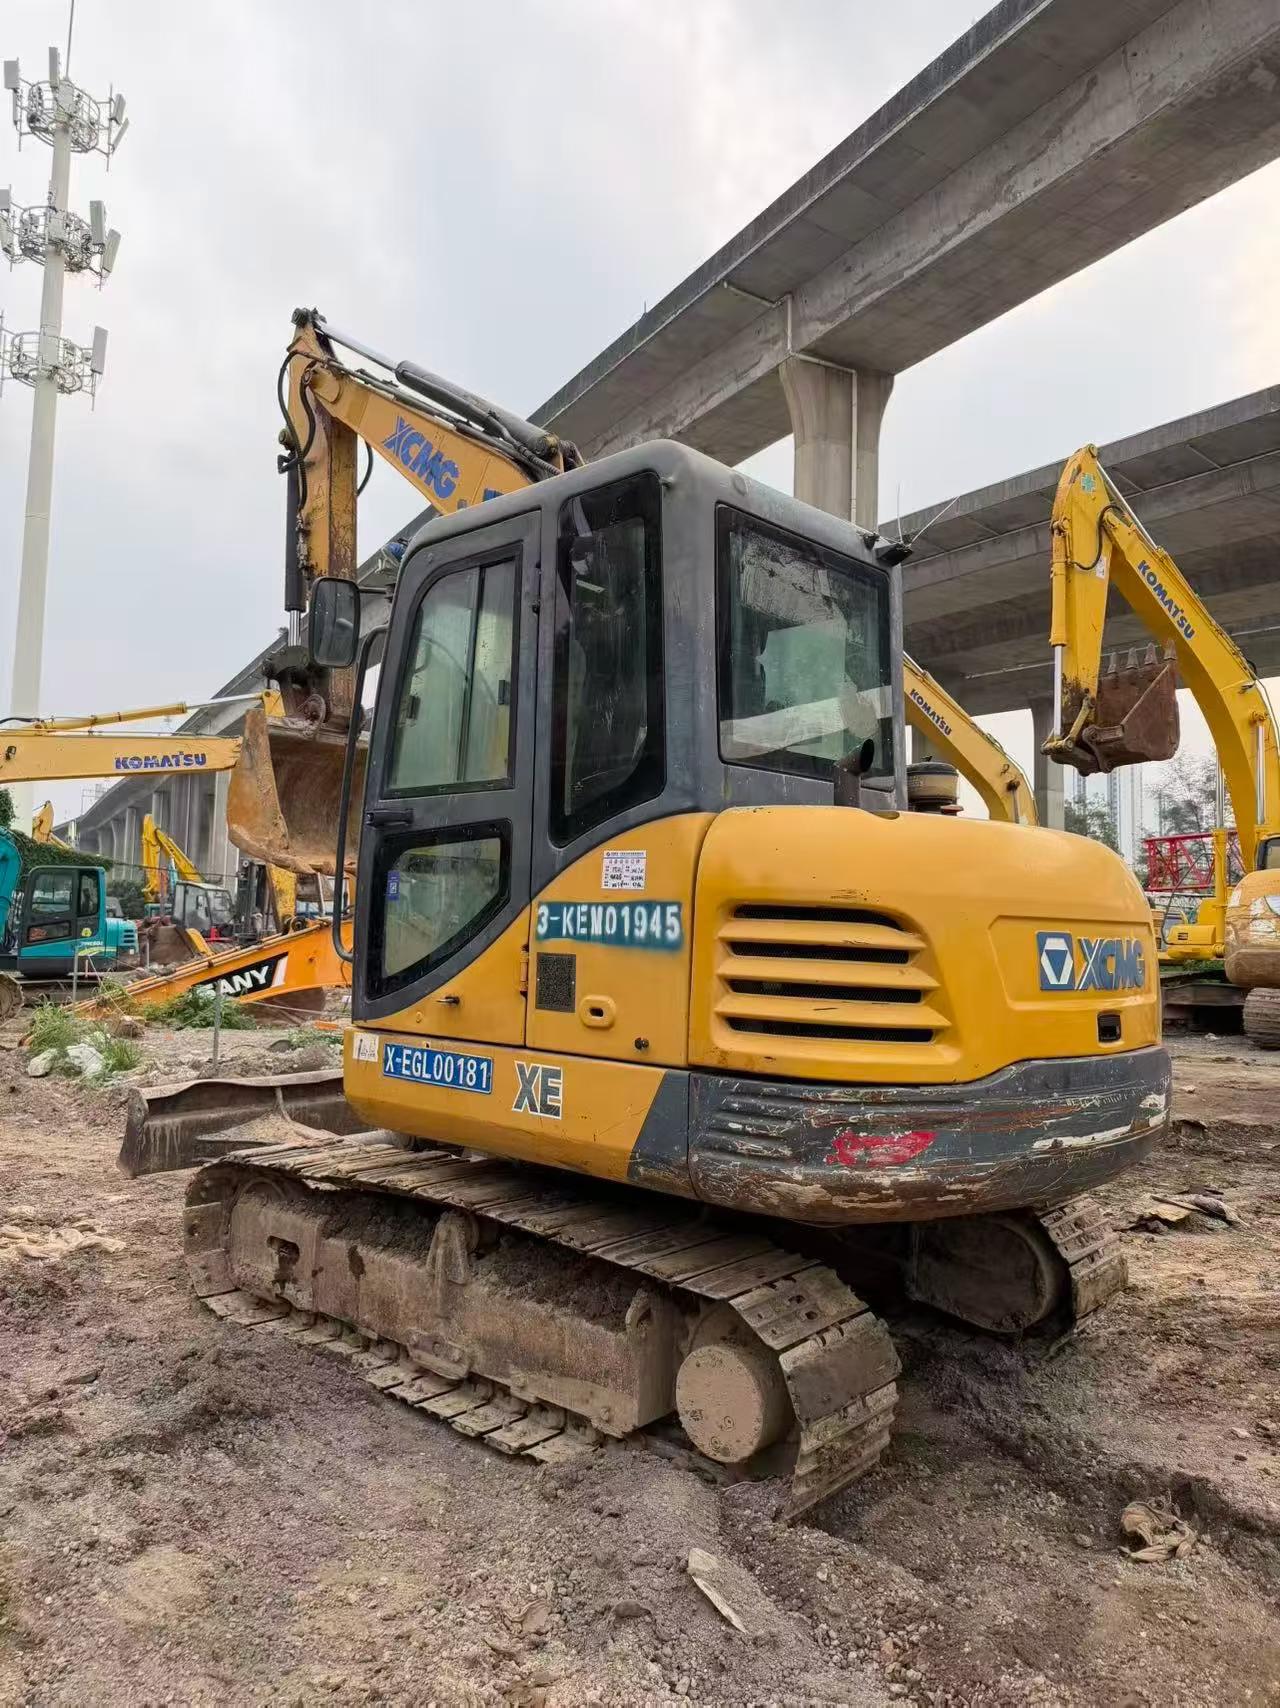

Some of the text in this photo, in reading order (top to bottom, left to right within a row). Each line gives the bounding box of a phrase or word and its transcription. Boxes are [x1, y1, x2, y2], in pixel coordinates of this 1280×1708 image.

[383, 415, 461, 499] XCMG
[1138, 560, 1196, 639] KOMATSU
[910, 689, 952, 736] KOMATSU
[115, 751, 207, 769] KOMATSU
[1075, 937, 1145, 990] XCMG
[385, 1046, 488, 1089] X-EGL00181
[512, 1060, 563, 1120] XE
